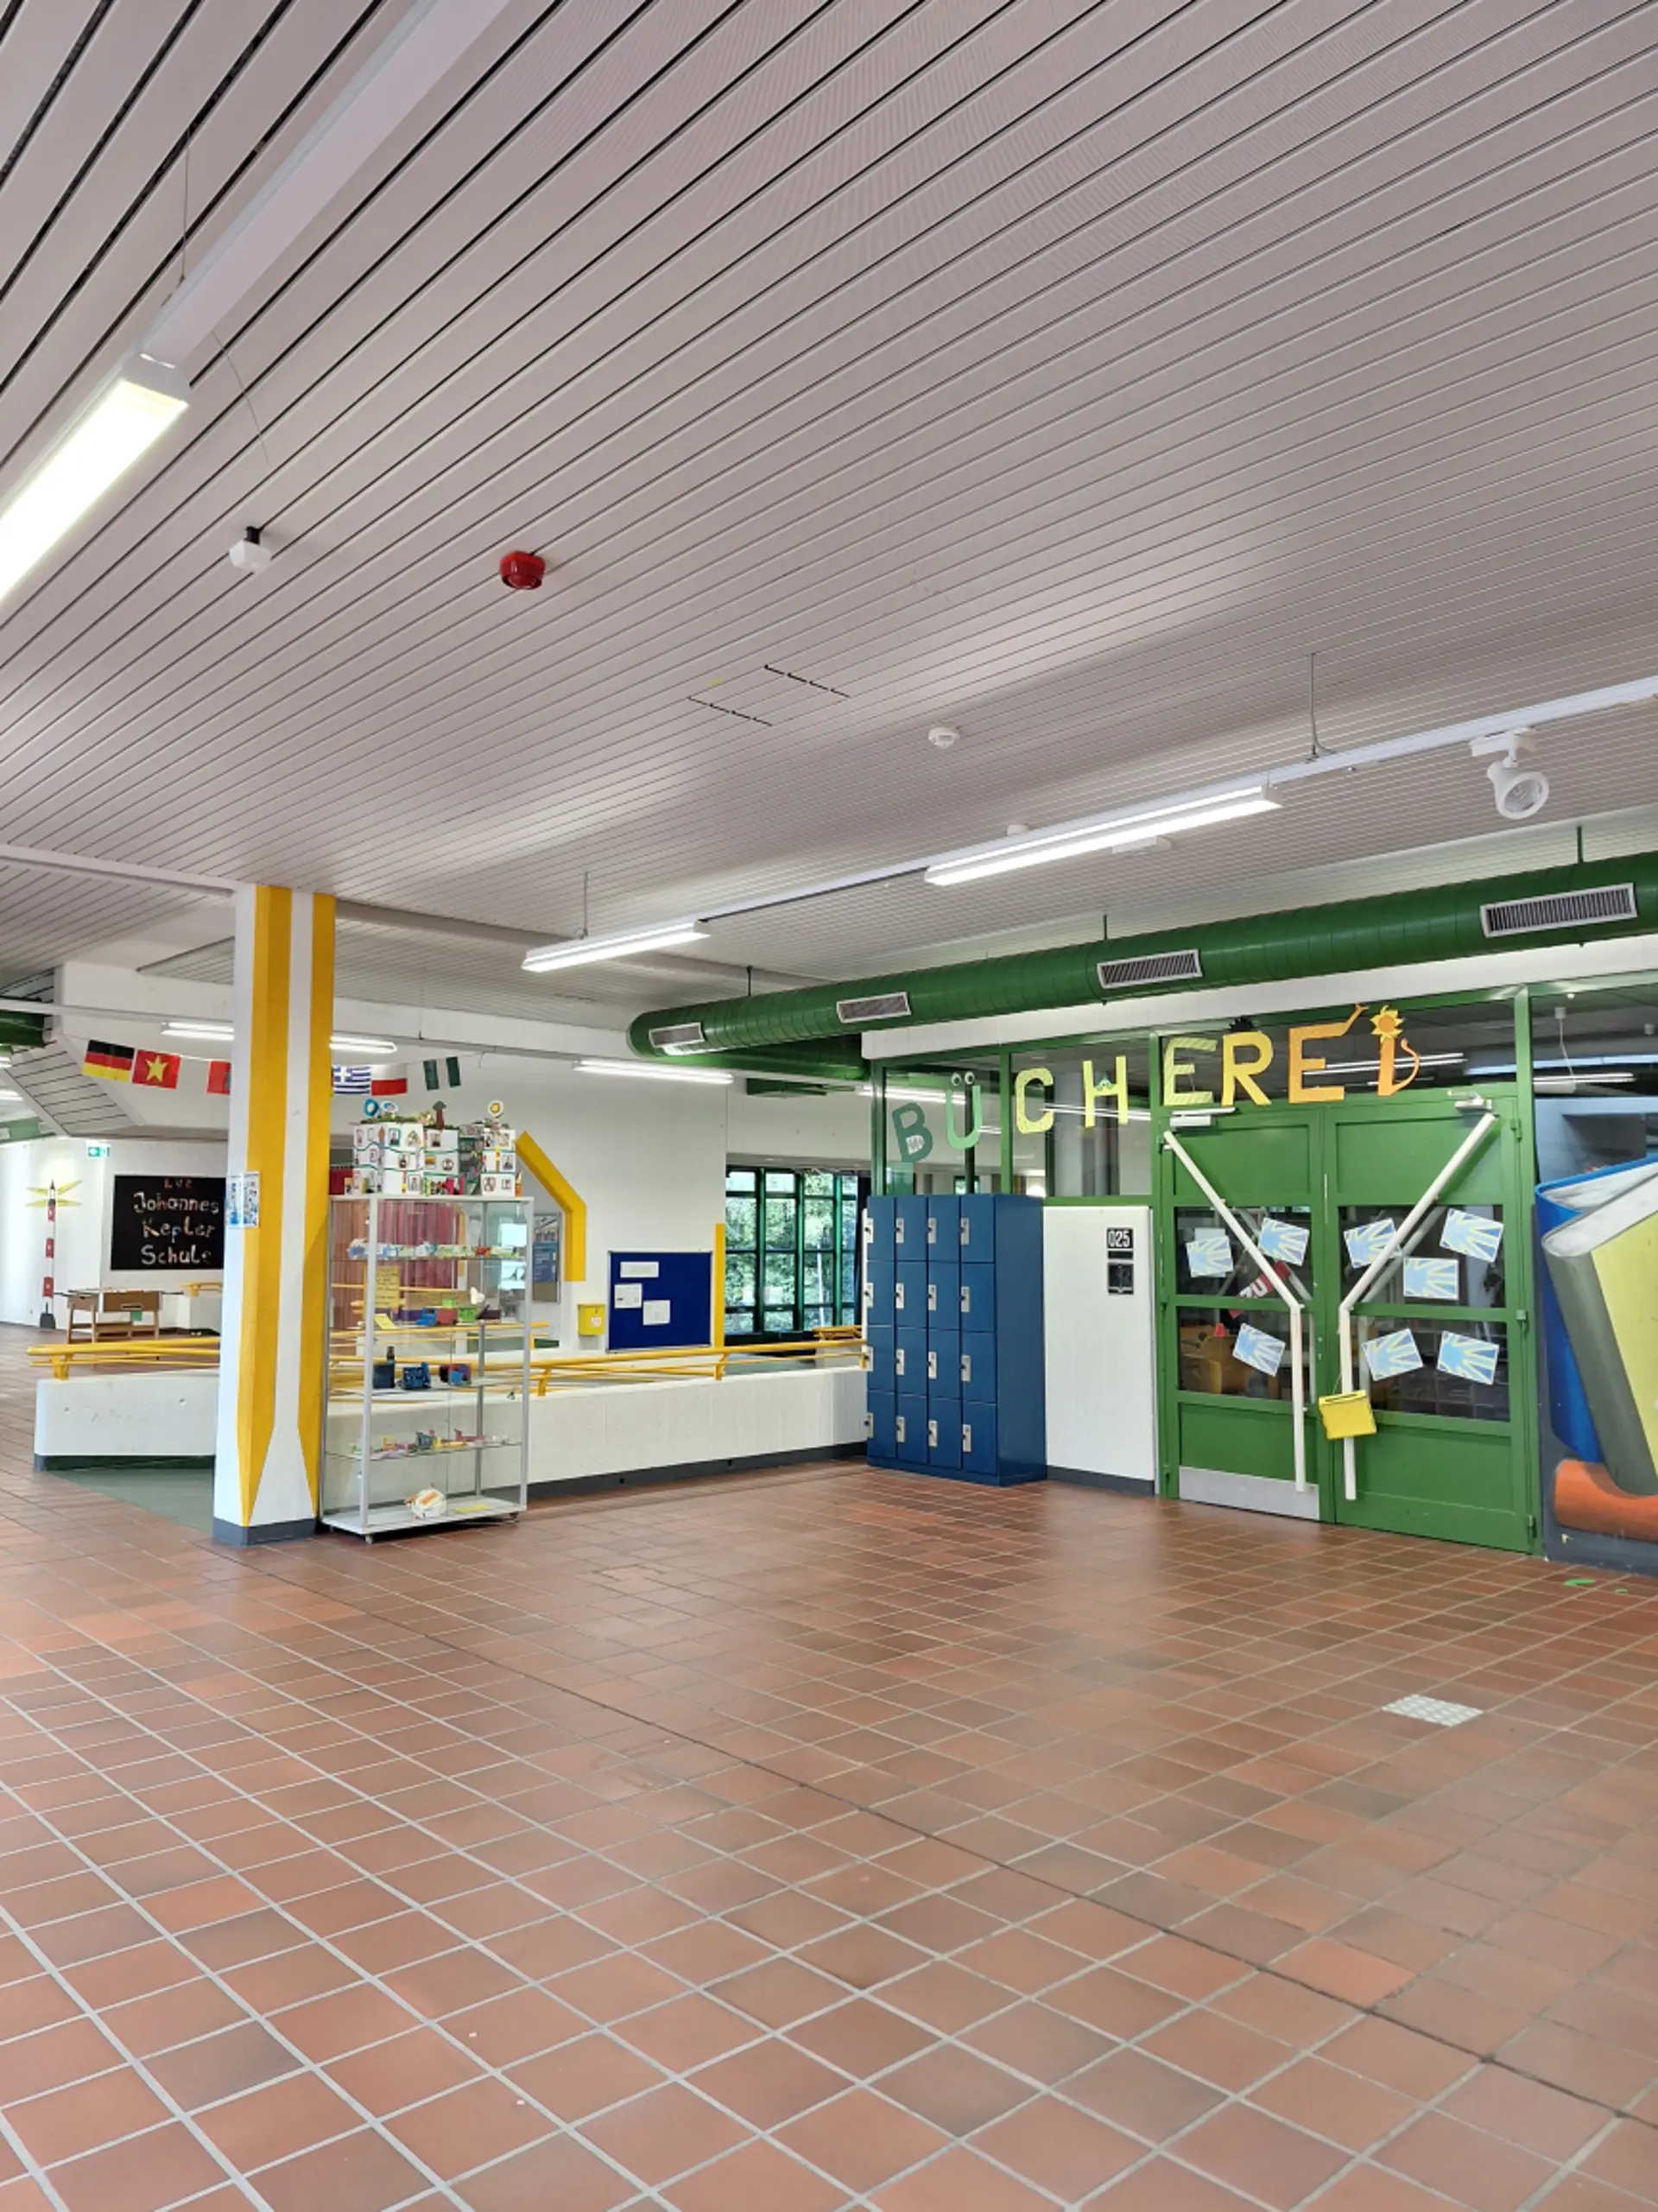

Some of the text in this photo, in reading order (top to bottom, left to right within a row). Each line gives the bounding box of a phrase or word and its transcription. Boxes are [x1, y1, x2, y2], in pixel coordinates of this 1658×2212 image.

[133, 1191, 219, 1214] Johannes
[142, 1216, 216, 1243] Kepler
[1108, 1230, 1130, 1247] 025
[141, 1245, 212, 1264] Schule
